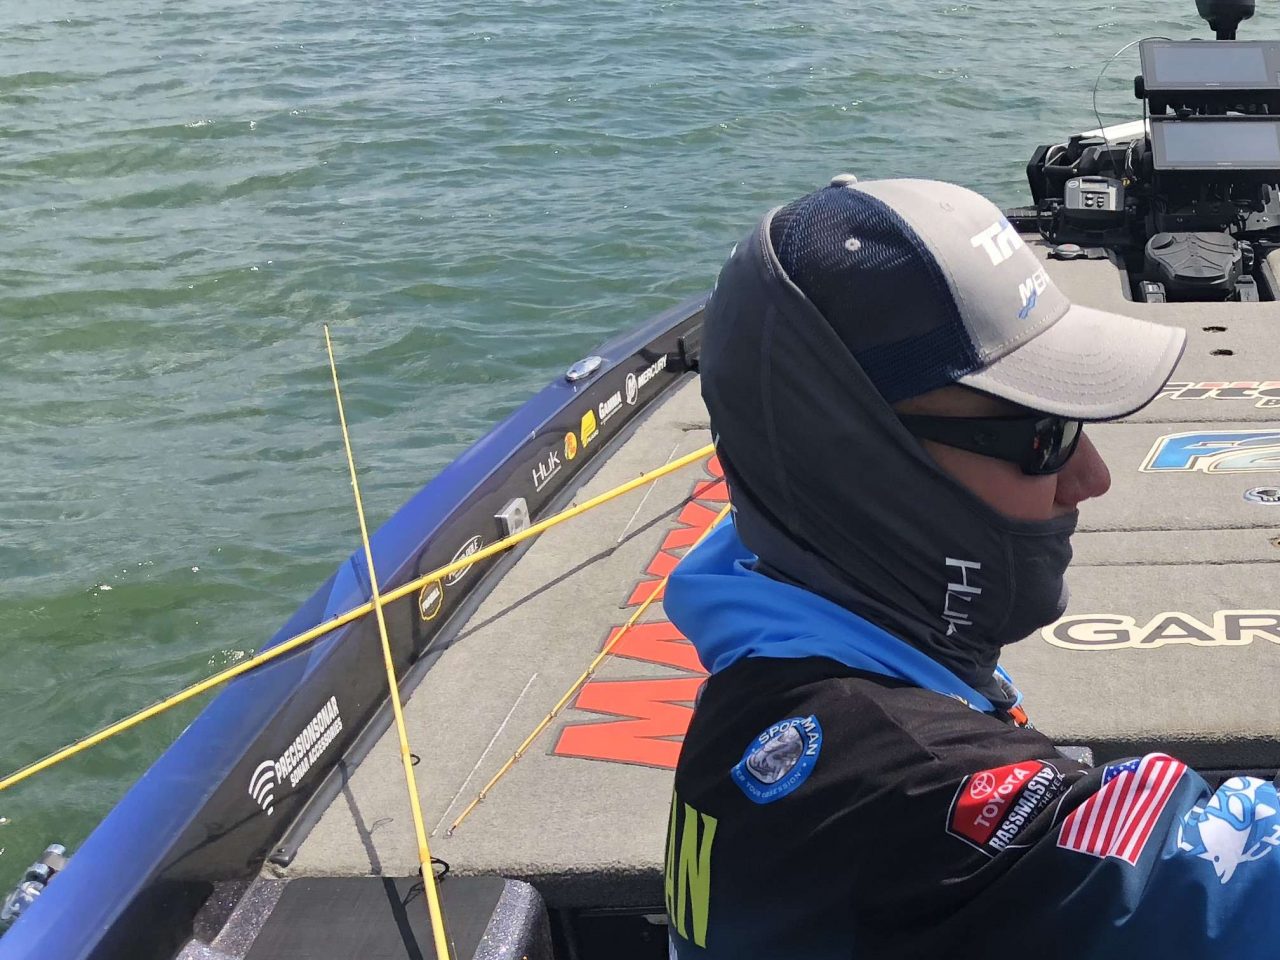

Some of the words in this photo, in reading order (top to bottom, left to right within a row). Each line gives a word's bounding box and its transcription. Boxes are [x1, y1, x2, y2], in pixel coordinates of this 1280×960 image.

[637, 354, 667, 388] MERCURY
[599, 391, 622, 420] GAMMA
[532, 451, 561, 487] Huk
[308, 716, 343, 766] ACCESSORIES
[974, 767, 1031, 828] TOYOTA
